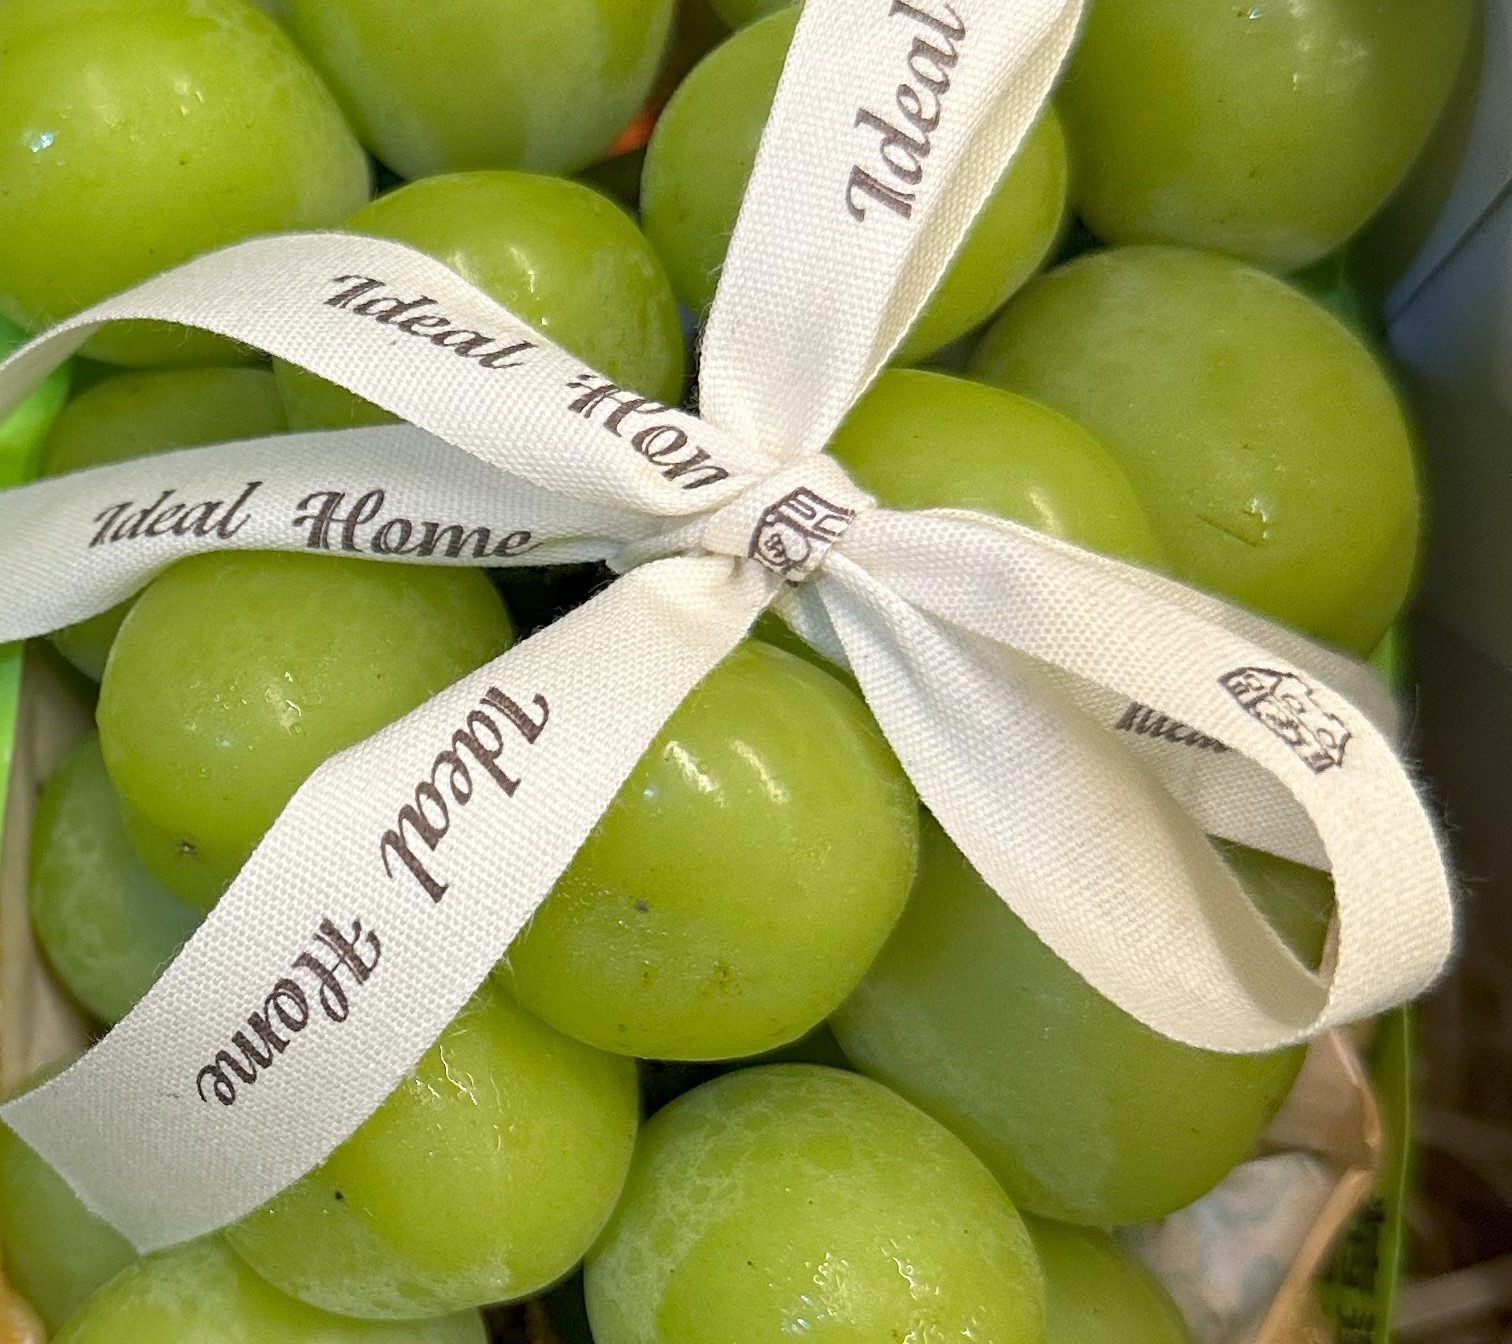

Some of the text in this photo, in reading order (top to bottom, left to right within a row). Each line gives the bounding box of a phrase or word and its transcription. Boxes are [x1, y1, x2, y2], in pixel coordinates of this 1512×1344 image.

[322, 272, 732, 491] Ideal Hom
[88, 480, 544, 562] Ideal Home
[195, 685, 551, 1107] Ideal Home
